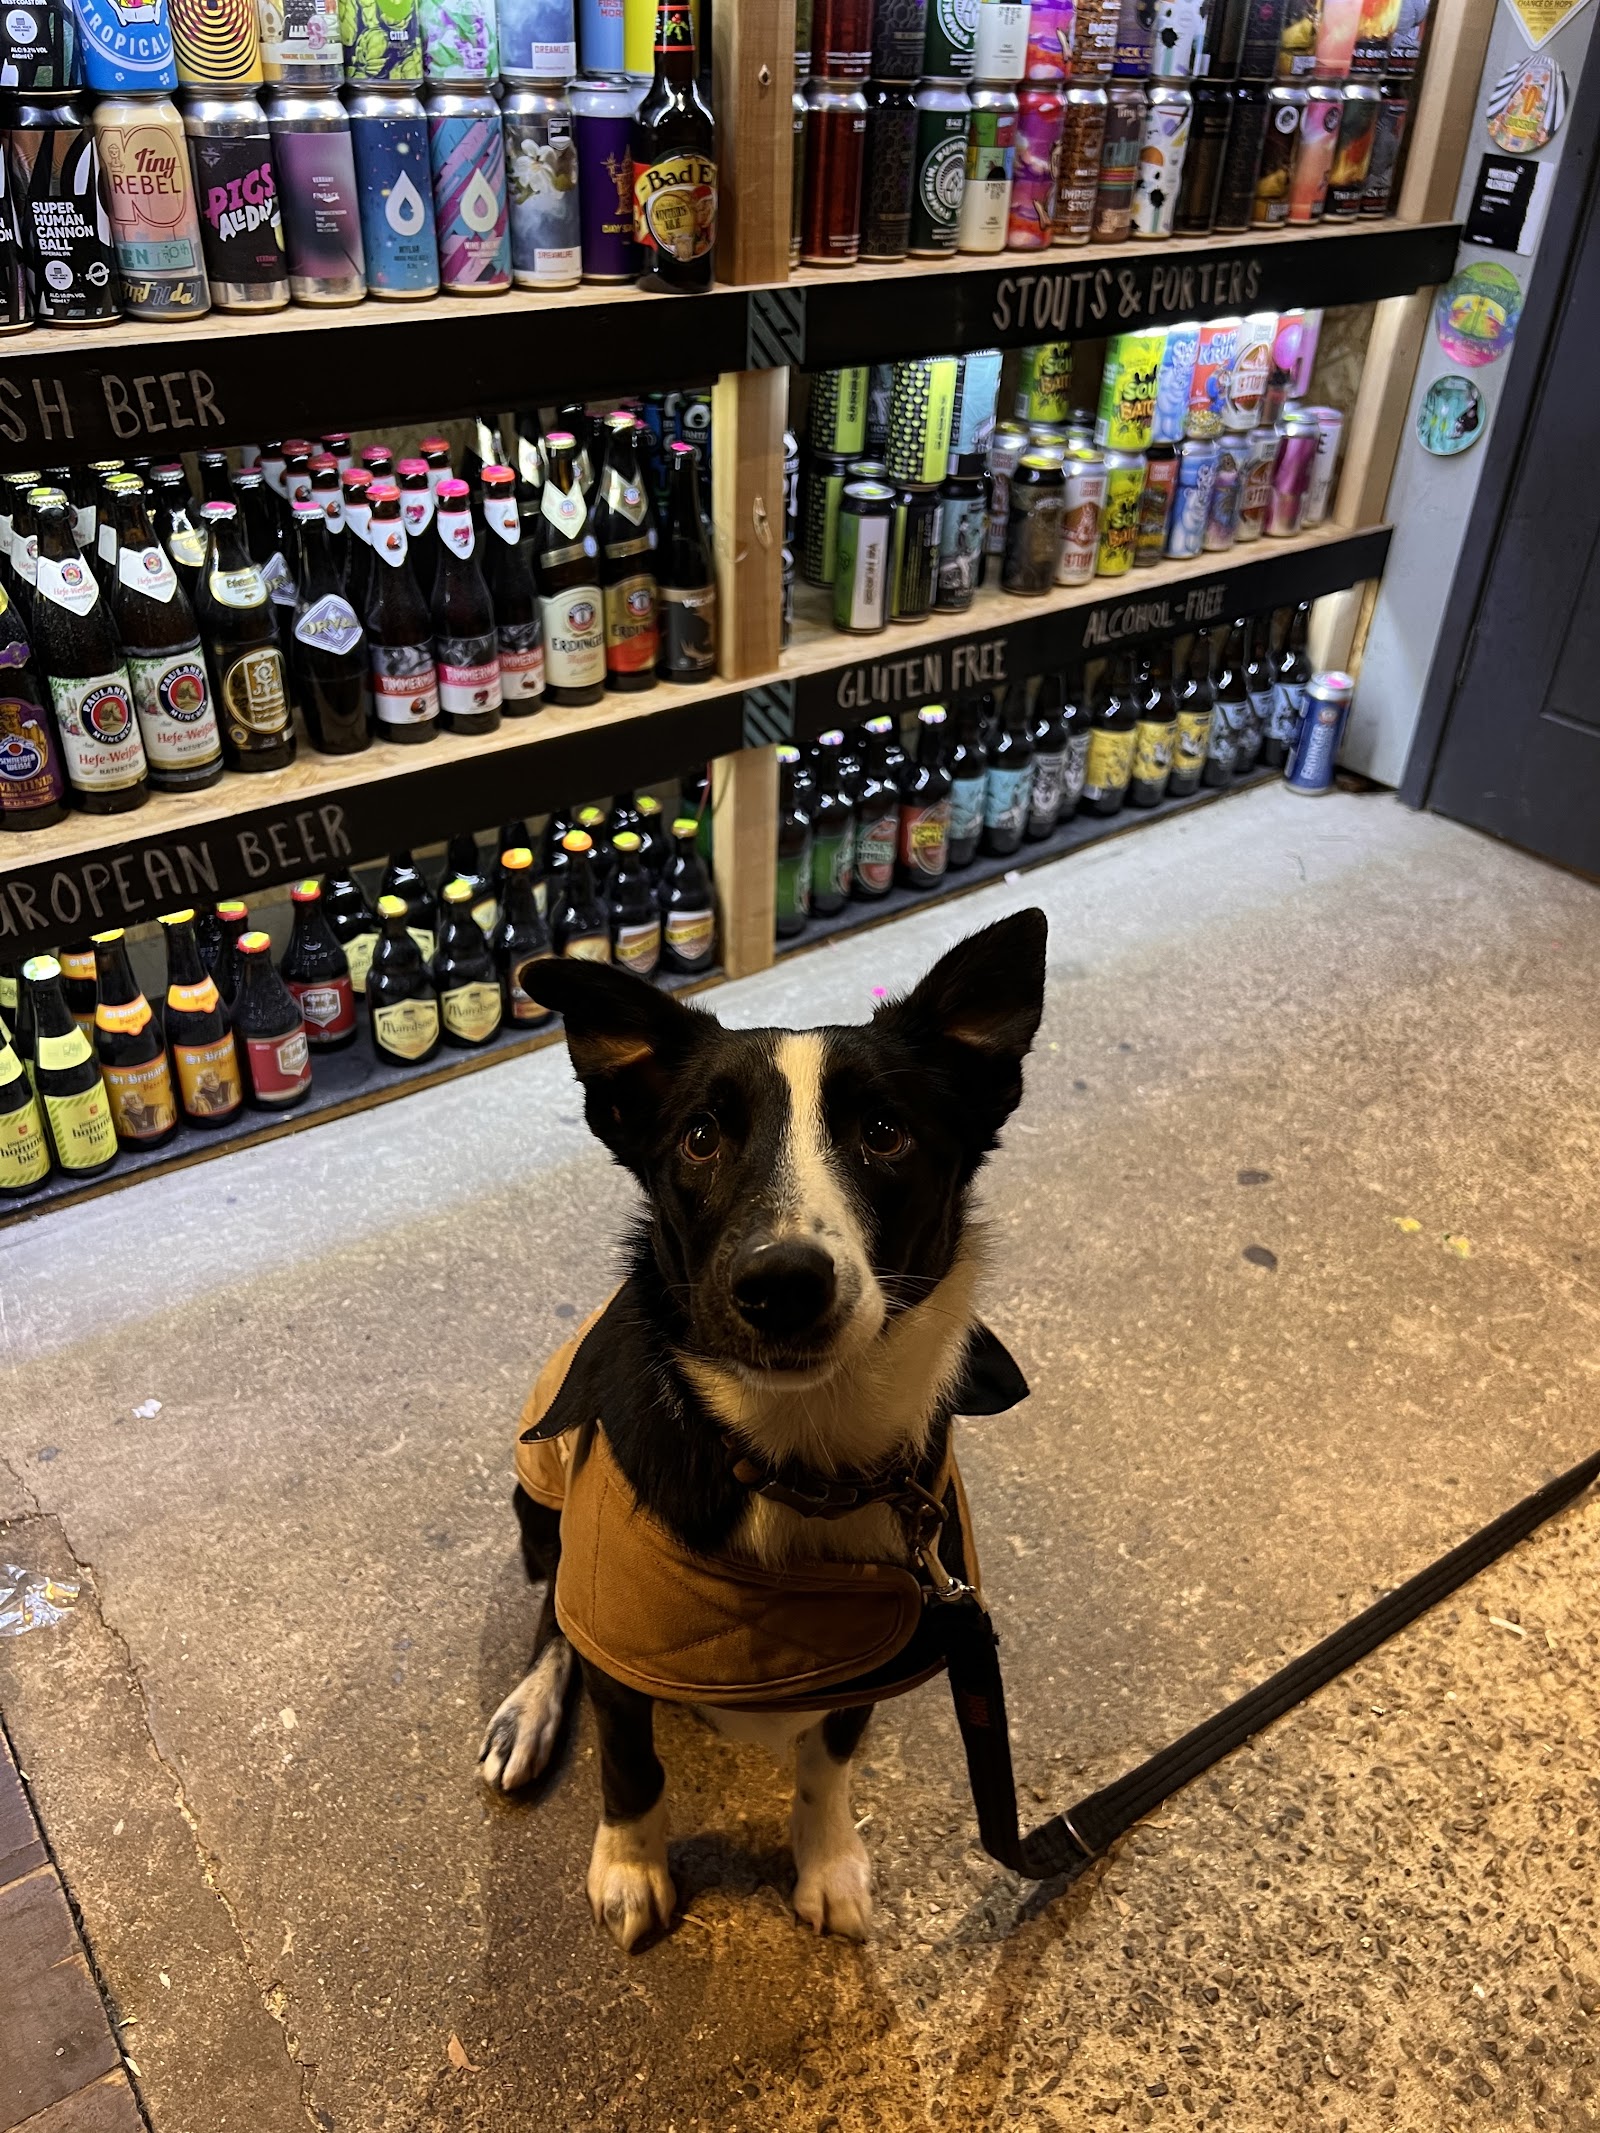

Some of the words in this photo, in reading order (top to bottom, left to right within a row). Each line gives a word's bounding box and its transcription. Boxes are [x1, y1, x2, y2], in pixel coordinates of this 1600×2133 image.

[82, 3, 169, 57] TROPICAL
[134, 148, 177, 178] Tiny
[113, 174, 182, 194] REBEL
[203, 163, 276, 229] PIGS
[32, 202, 75, 214] SUPER
[34, 214, 85, 226] HUMAN
[36, 225, 94, 239] CANNON
[39, 239, 73, 250] BALL
[992, 267, 1113, 331] STOUTS
[1117, 269, 1143, 319] &
[1148, 259, 1262, 316] PORTERS
[101, 369, 226, 440] BEER
[837, 654, 943, 709] GLUTEN
[952, 640, 1008, 690] FREE
[82, 685, 128, 713] PAULANER
[237, 804, 352, 878] BEER
